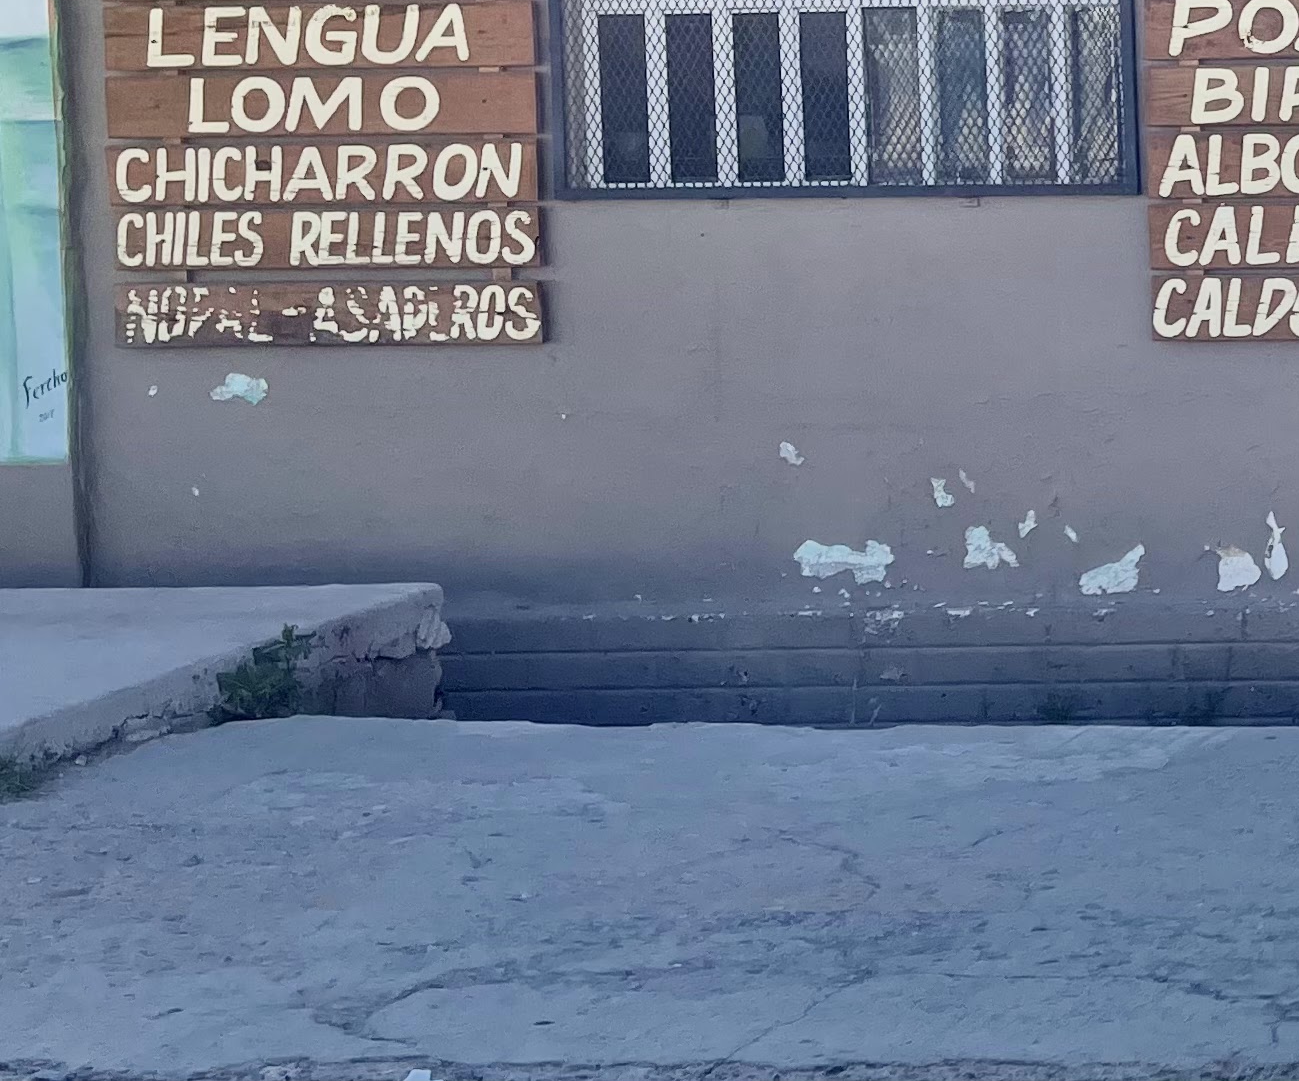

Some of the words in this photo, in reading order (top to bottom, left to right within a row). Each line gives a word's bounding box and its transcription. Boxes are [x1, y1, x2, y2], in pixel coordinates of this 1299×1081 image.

[147, 4, 469, 67] LENGUA
[188, 76, 440, 133] LOMO
[115, 143, 522, 202] CHICHARRON
[117, 211, 263, 266] CHILES
[290, 210, 536, 265] RELLENOS
